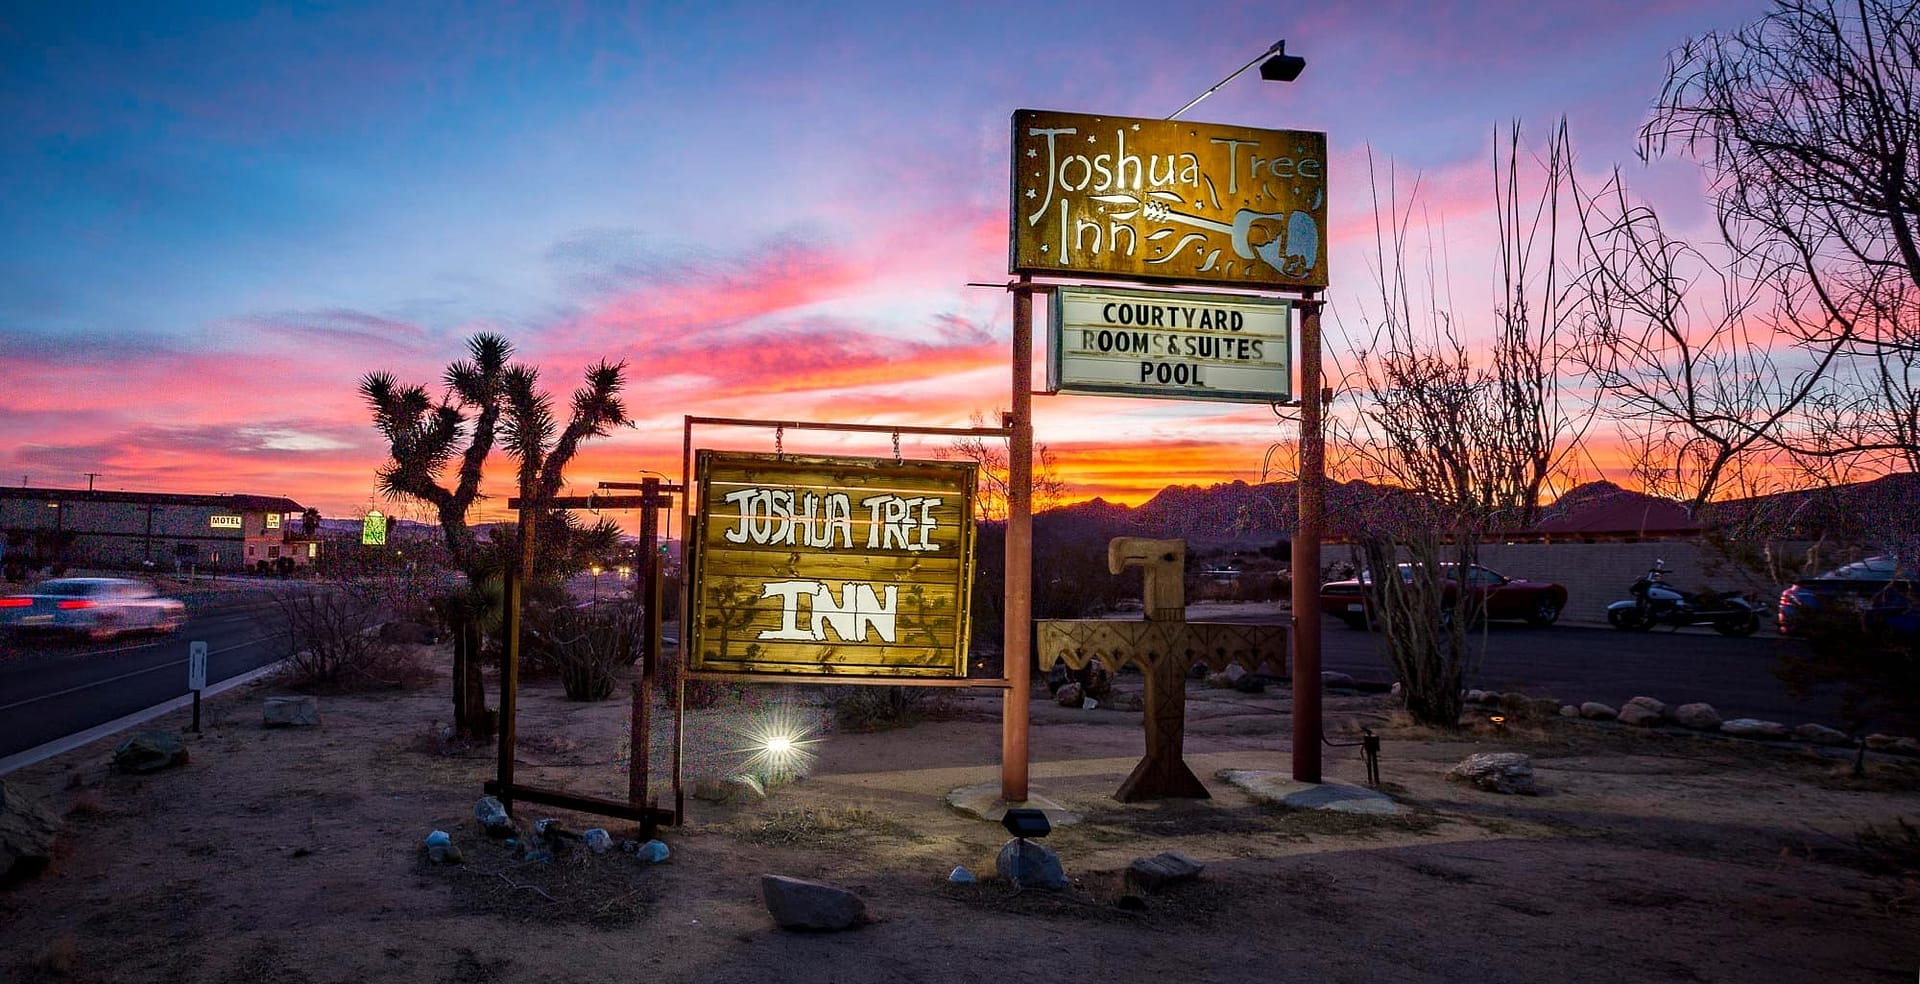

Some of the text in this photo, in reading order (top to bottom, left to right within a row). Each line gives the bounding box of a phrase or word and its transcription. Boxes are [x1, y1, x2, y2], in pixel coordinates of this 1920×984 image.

[1029, 128, 1321, 226] Joshua Tree
[1059, 199, 1136, 265] Inn
[1103, 303, 1243, 331] COURTYARD
[1140, 362, 1204, 386] POOL
[212, 517, 240, 525] MOTEL
[724, 488, 944, 550] JOSHUA TREE
[757, 580, 898, 642] INN
